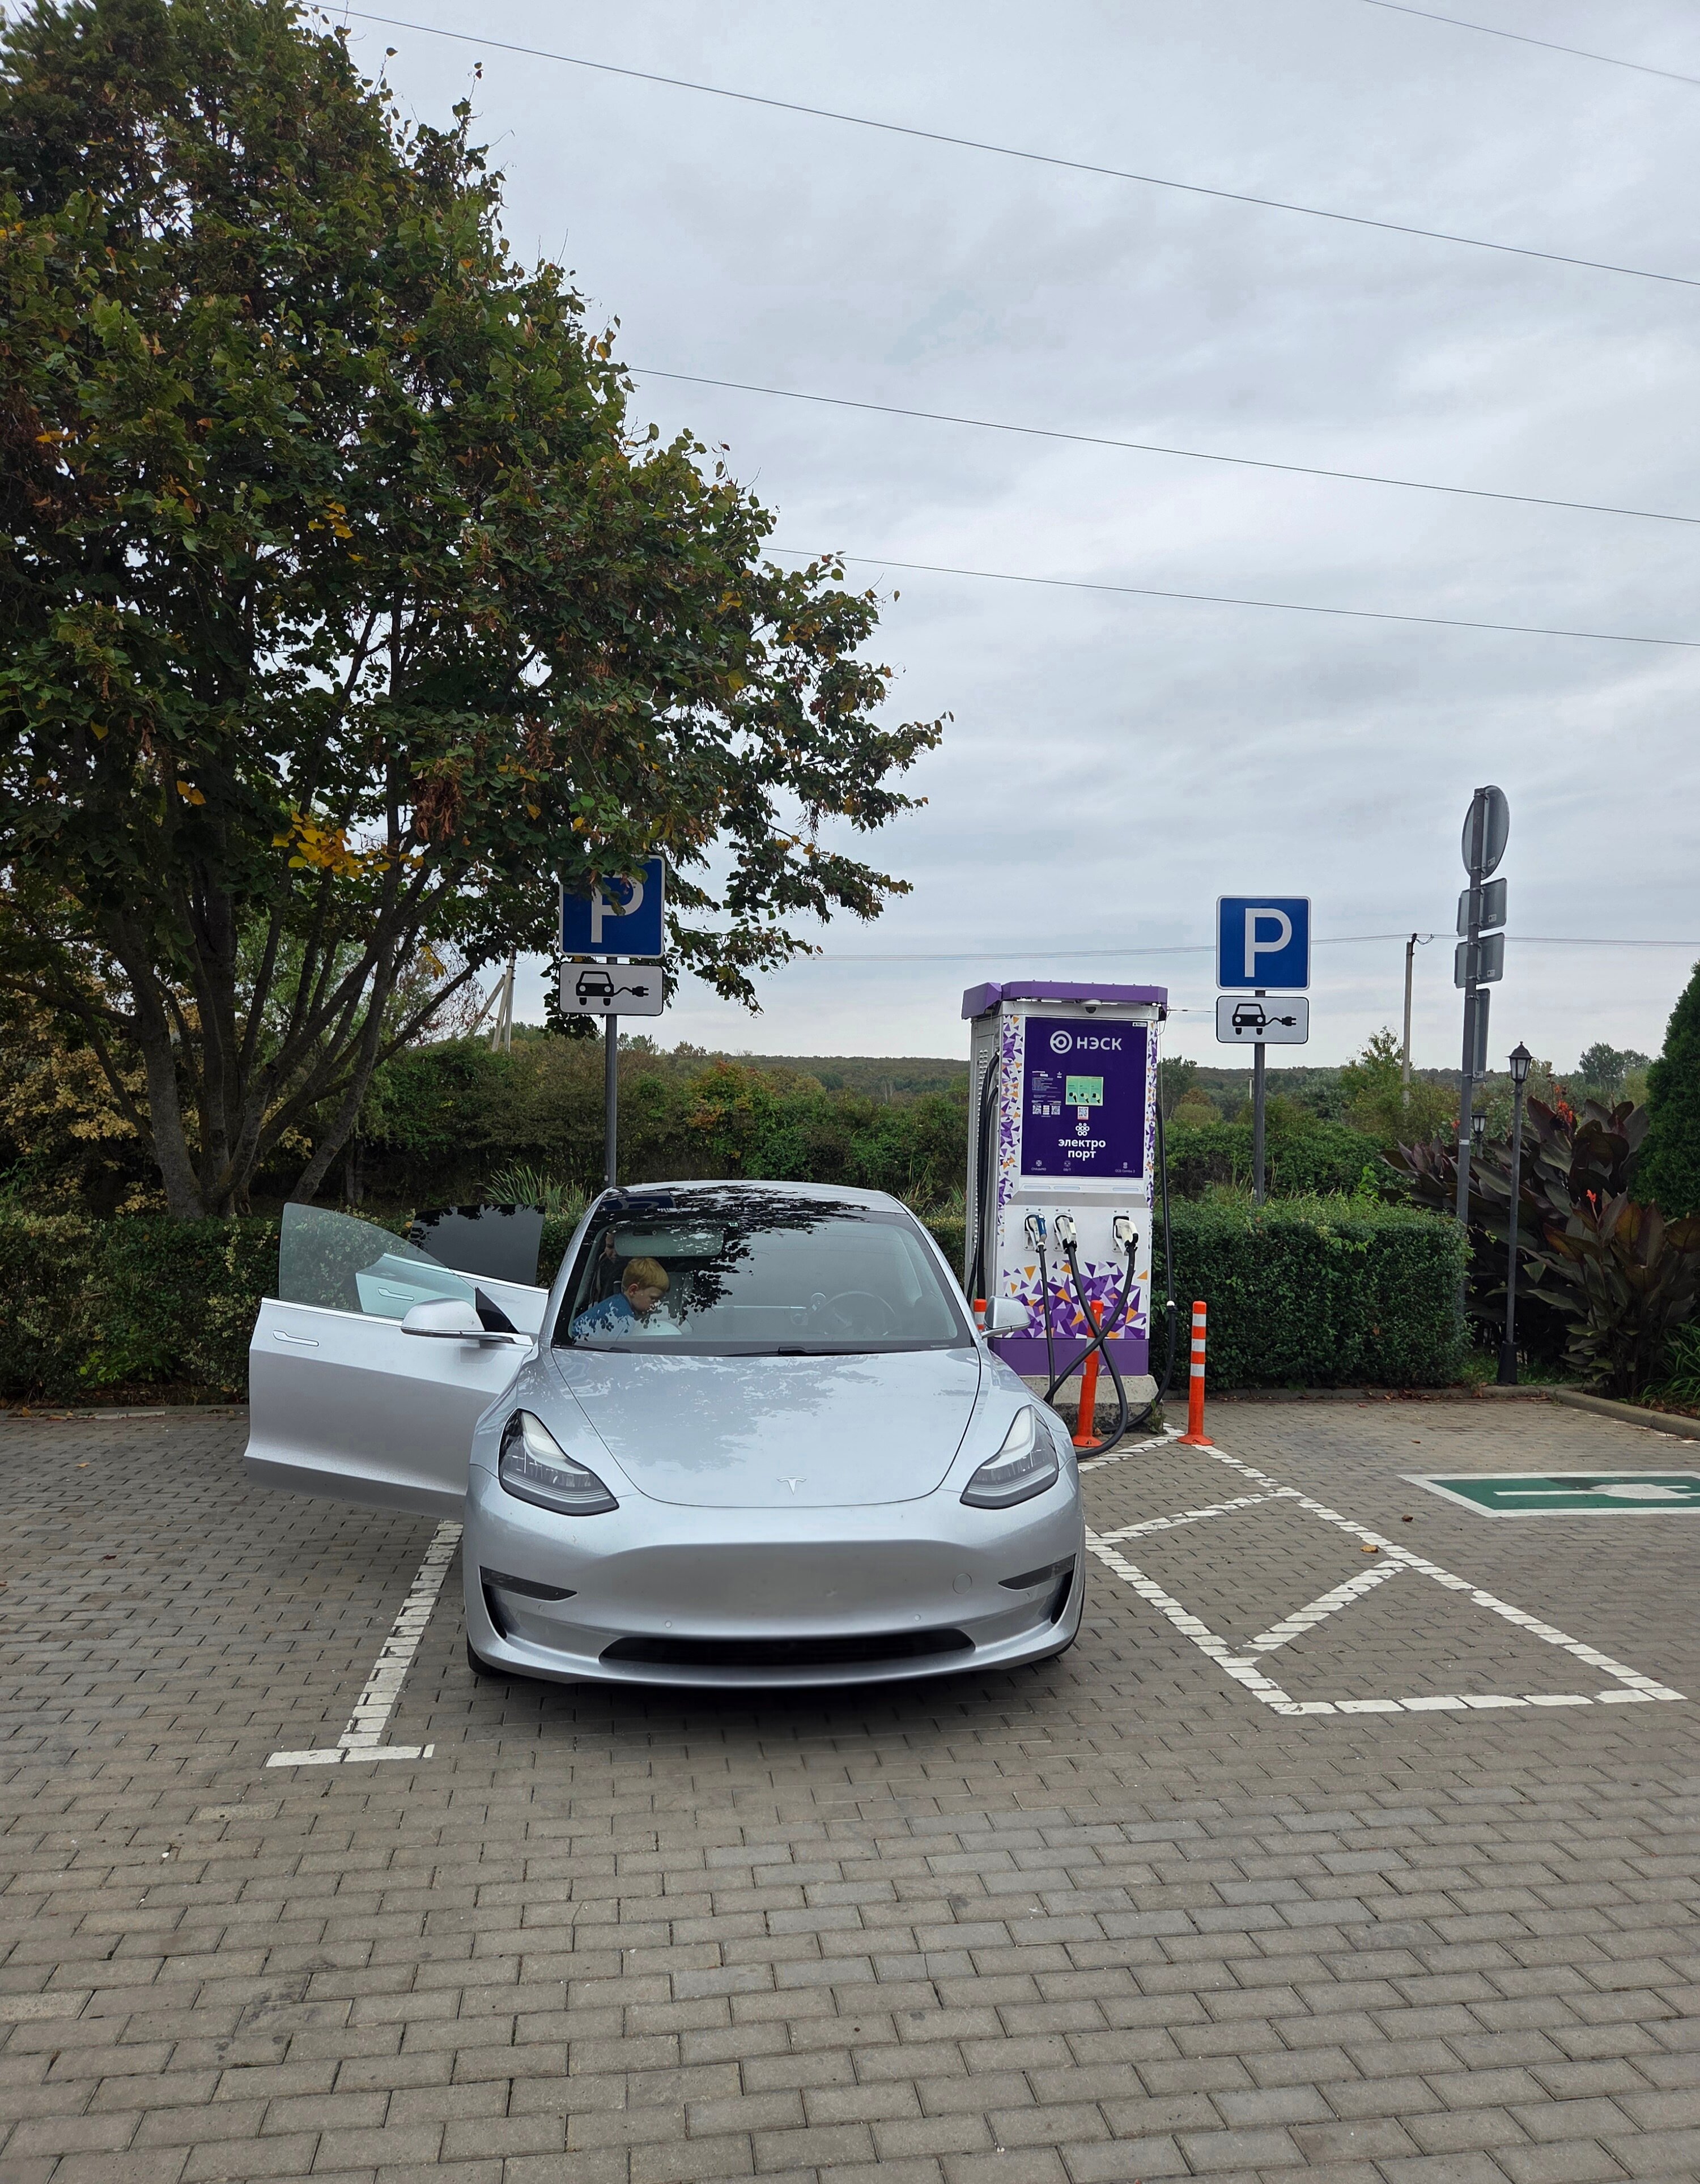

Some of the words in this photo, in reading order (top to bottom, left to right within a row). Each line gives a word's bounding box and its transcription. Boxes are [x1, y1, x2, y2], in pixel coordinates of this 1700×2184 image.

[591, 868, 644, 943] P
[1244, 908, 1293, 978] P
[1077, 1036, 1122, 1051] НЭСК
[1058, 1138, 1106, 1151] электро
[1068, 1150, 1096, 1161] порт
